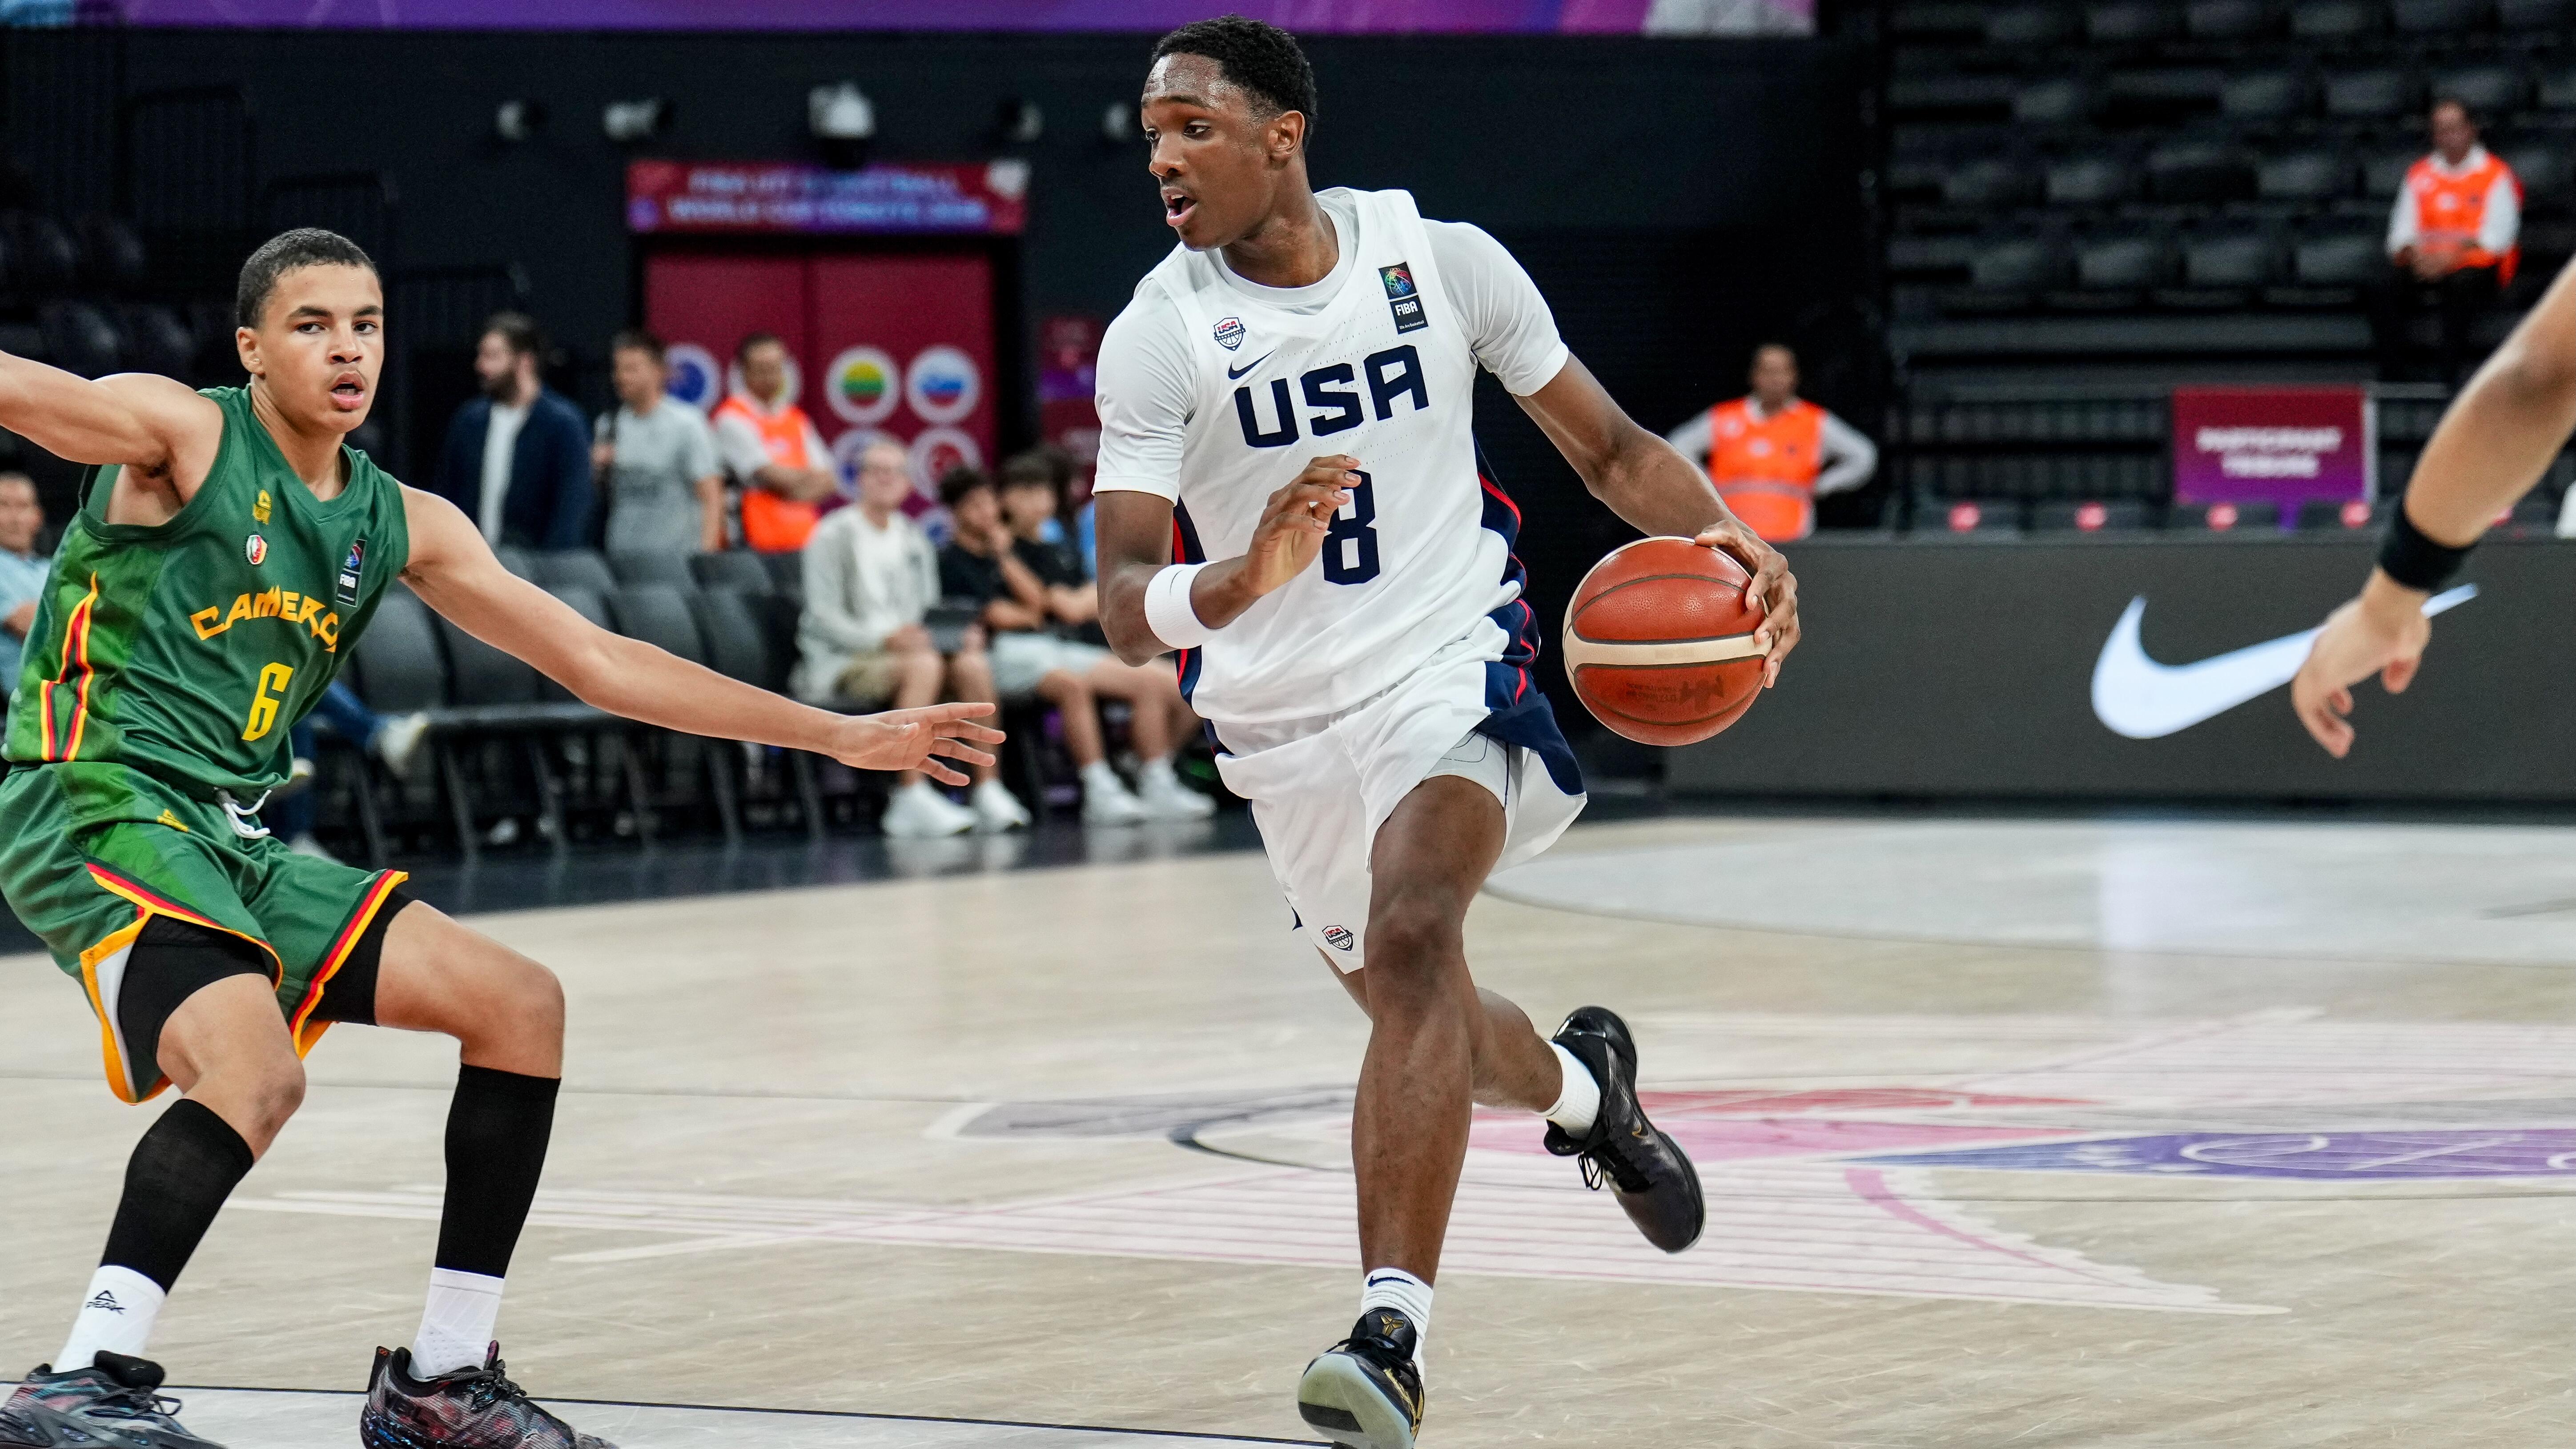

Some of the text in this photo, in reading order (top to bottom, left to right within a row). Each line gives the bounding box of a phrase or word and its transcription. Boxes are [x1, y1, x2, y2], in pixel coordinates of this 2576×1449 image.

[1217, 321, 1238, 334] USA
[1395, 301, 1418, 316] FIBA
[1234, 345, 1429, 448] USA
[1322, 469, 1380, 585] 8
[242, 662, 294, 741] 6
